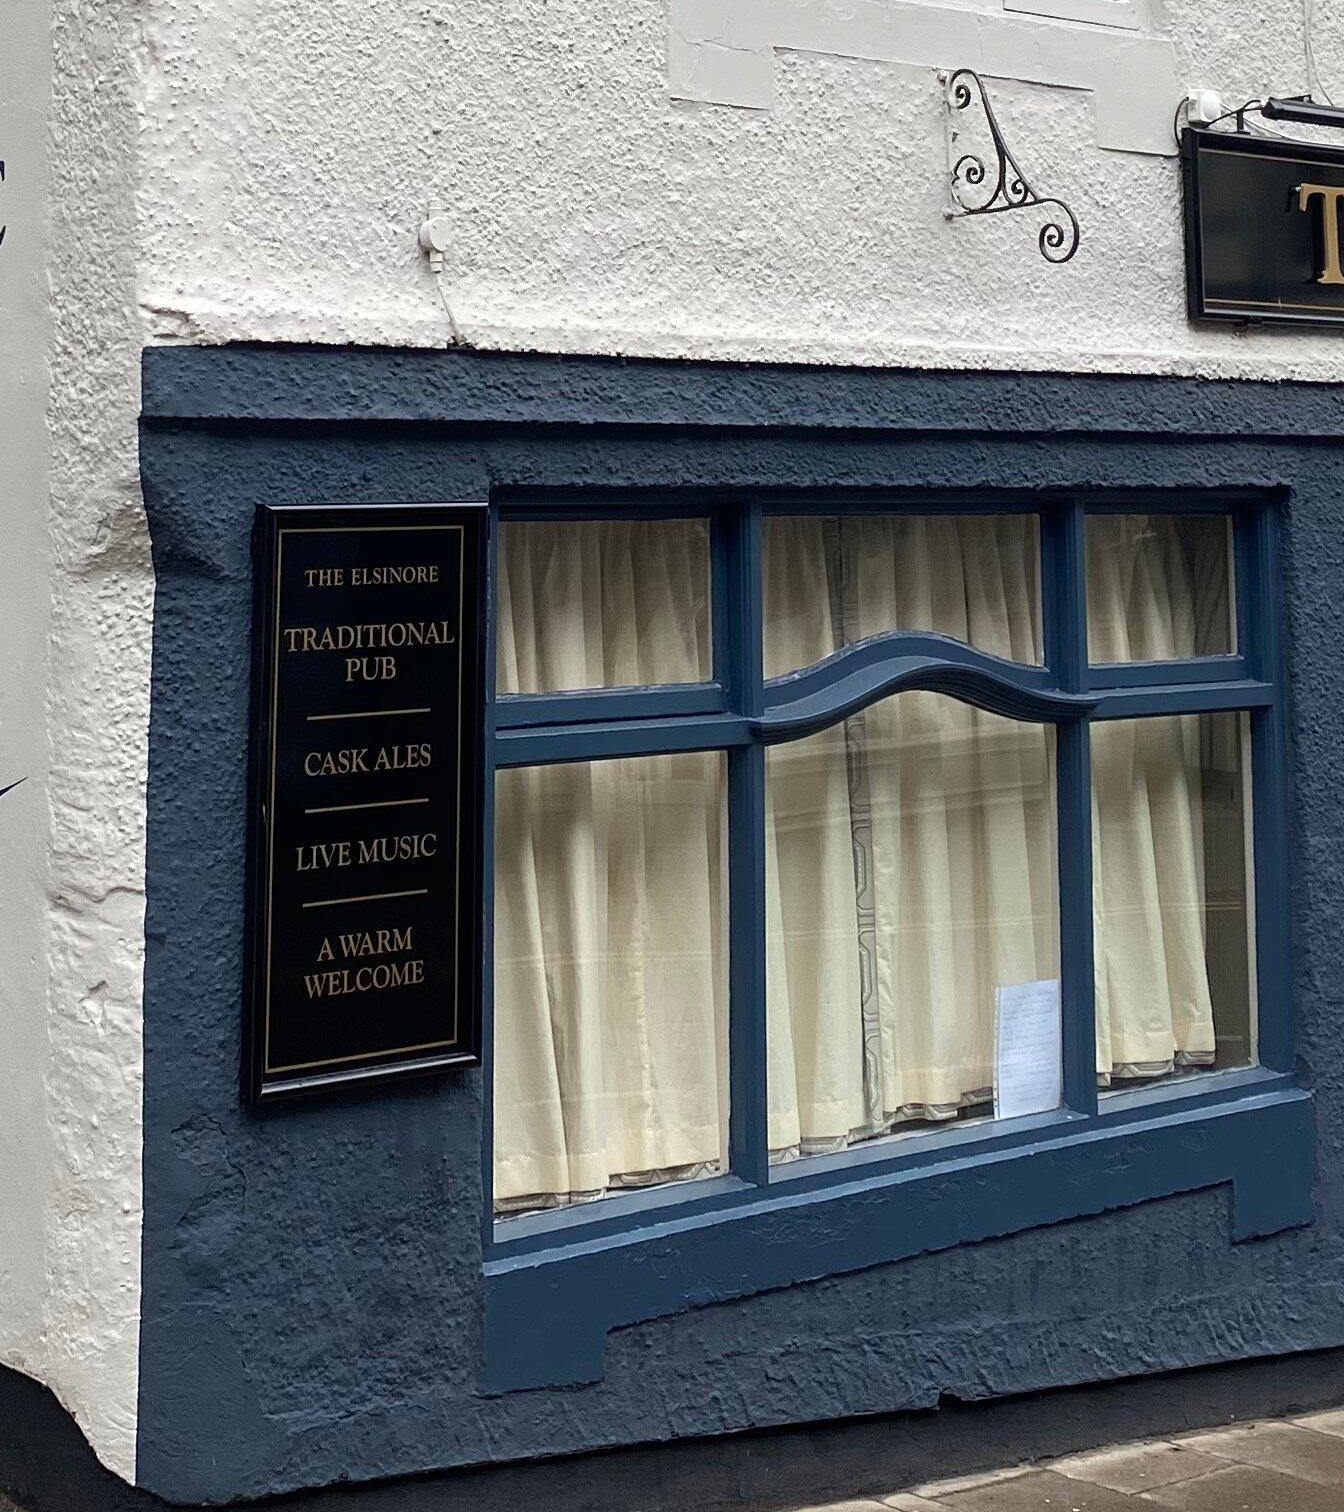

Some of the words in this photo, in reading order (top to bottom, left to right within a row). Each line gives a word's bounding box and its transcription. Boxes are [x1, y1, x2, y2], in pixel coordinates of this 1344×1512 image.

[304, 568, 344, 588] THE
[351, 565, 439, 586] ELSINORE
[283, 621, 455, 652] TRADITIONAL
[344, 656, 397, 682] PUB
[304, 747, 369, 777] CASK
[373, 743, 432, 772] ALES
[296, 841, 352, 871] LIVE
[358, 833, 437, 864] MUSIC
[316, 937, 335, 962] A
[338, 926, 413, 958] WARM
[304, 959, 425, 999] WELCOME
